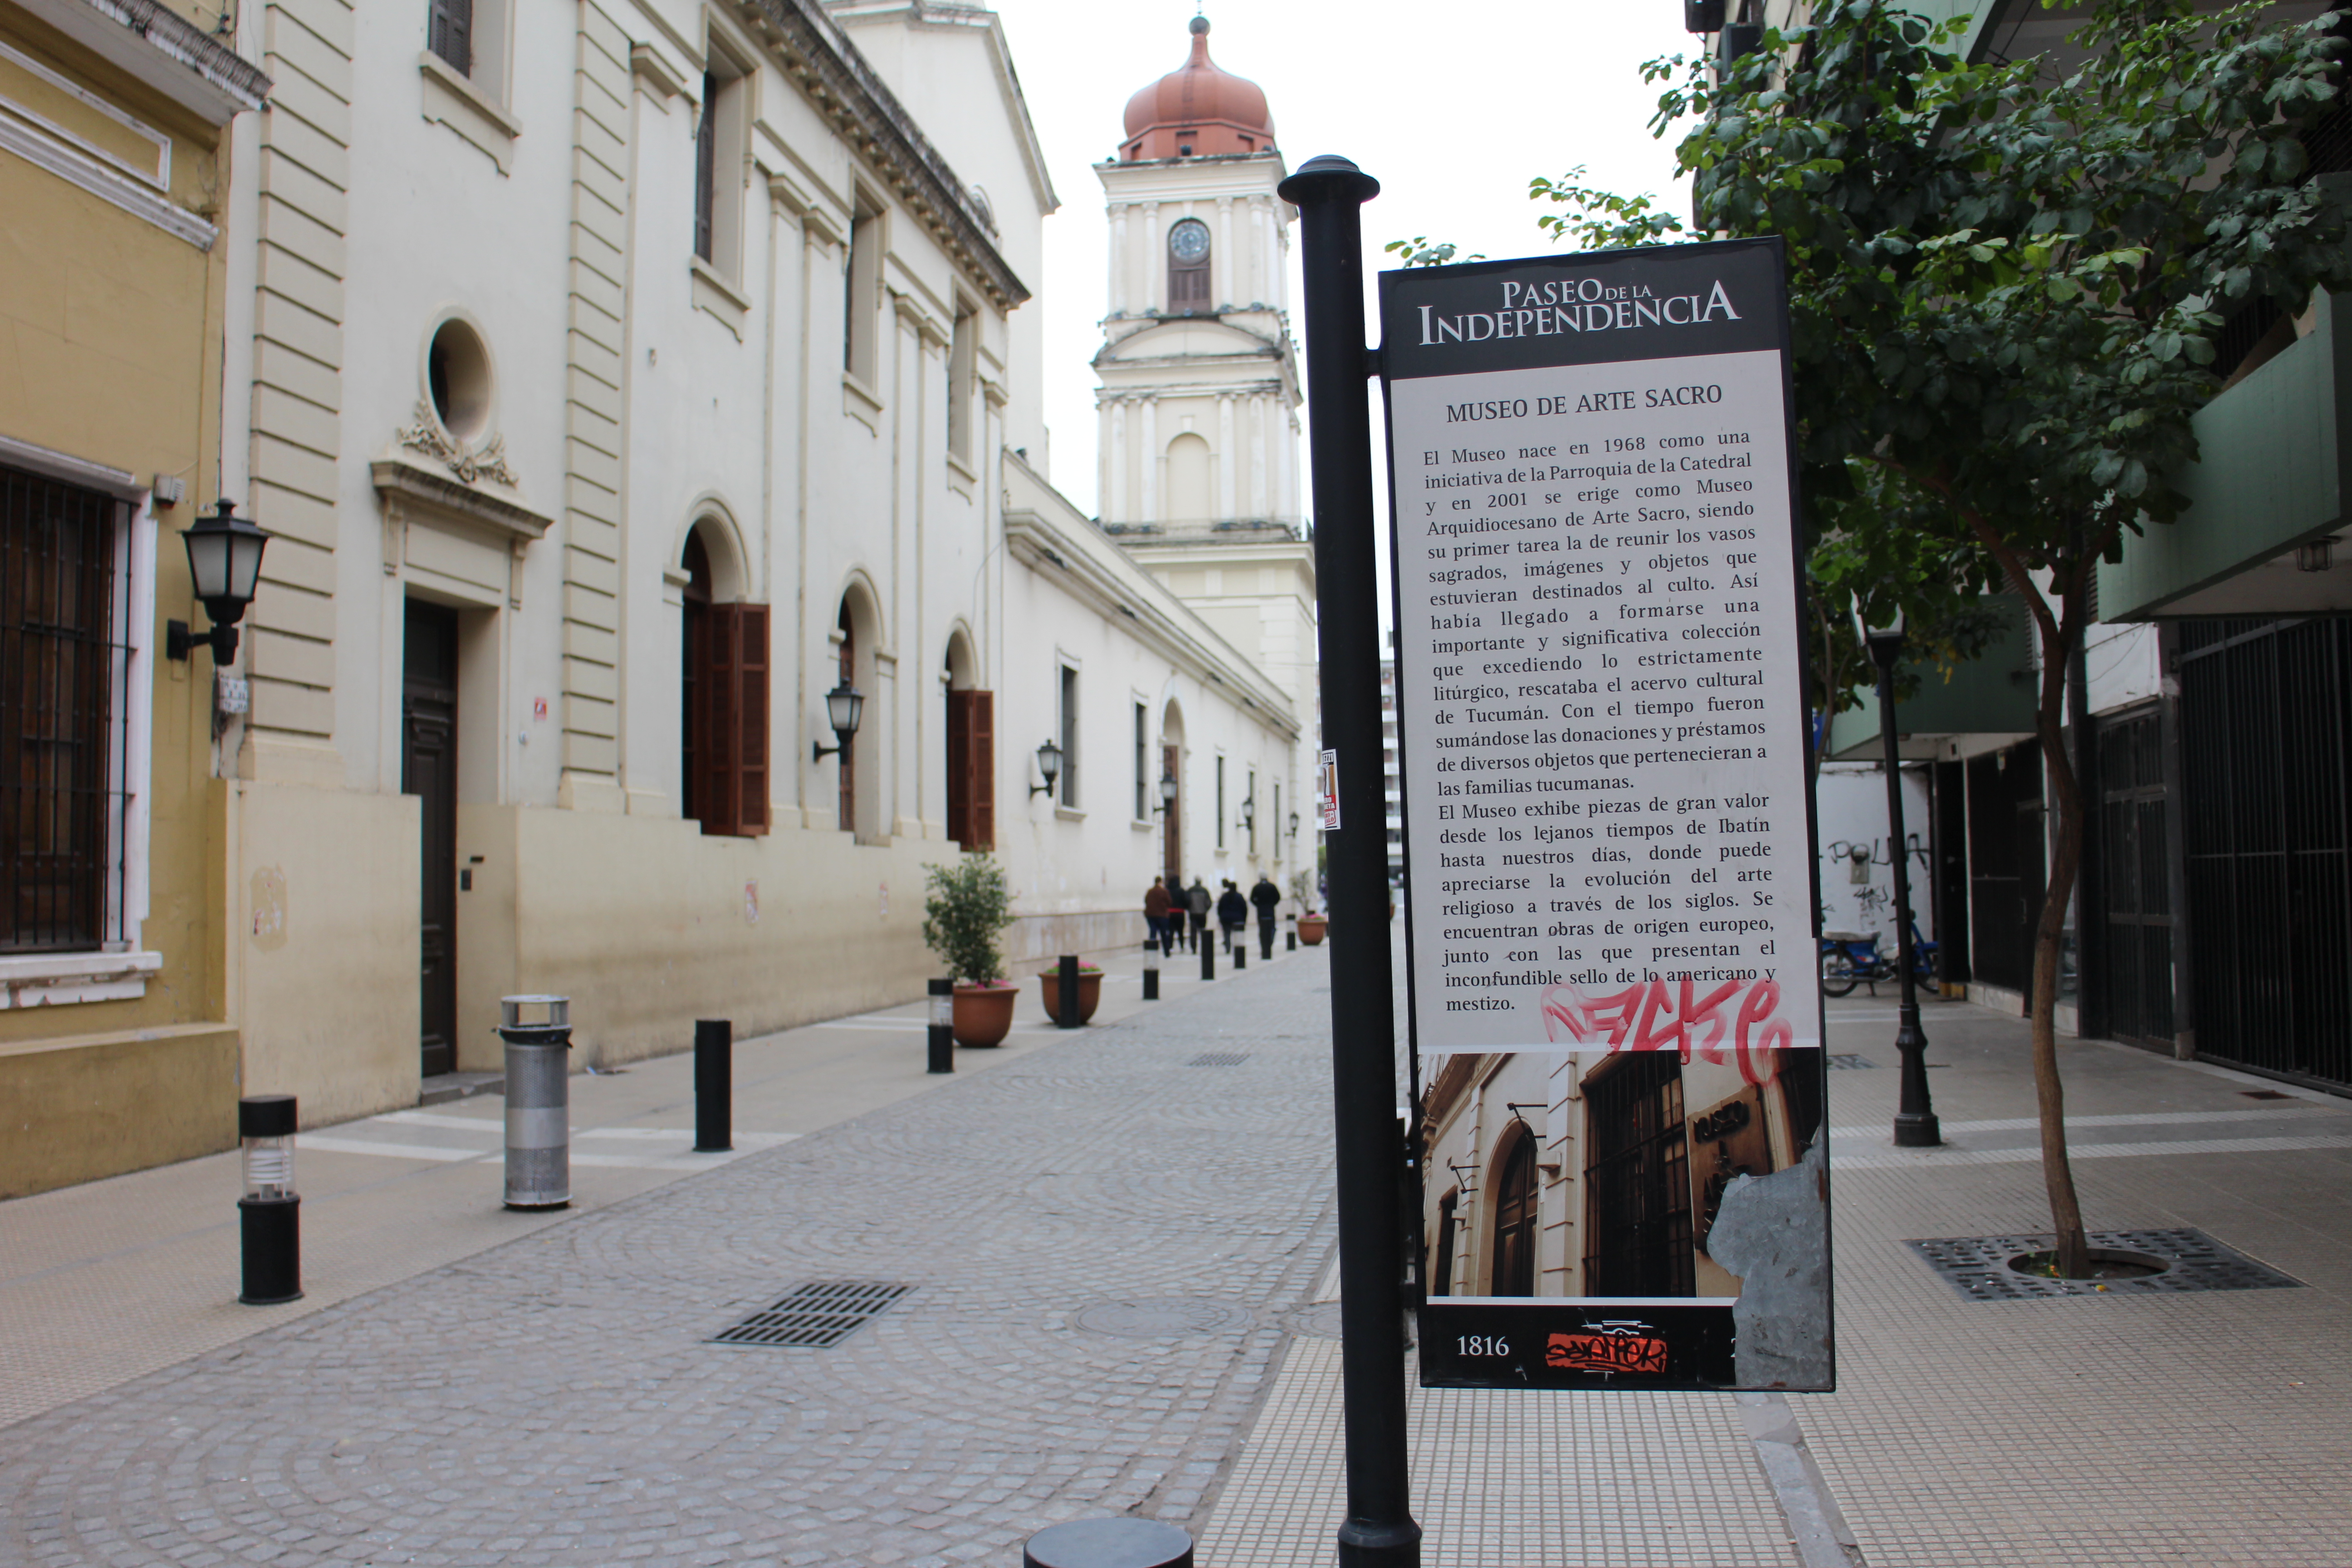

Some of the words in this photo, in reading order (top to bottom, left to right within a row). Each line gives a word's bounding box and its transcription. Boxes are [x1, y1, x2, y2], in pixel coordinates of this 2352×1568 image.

[1500, 278, 1602, 309] PASEO
[1605, 286, 1627, 300] DE
[1632, 285, 1653, 298] LA
[1417, 279, 1742, 346] INDEPENDENCIA
[1446, 398, 1529, 424] MUSEO
[1535, 395, 1568, 417] DE
[1574, 390, 1637, 414] ARTE
[1645, 383, 1723, 409] SACRO
[1423, 450, 1440, 466] El
[1450, 448, 1506, 464] Museo
[1518, 445, 1557, 459] nace
[1568, 443, 1590, 456] en
[1603, 436, 1646, 453] 1968
[1658, 435, 1705, 450] como
[1717, 432, 1751, 446] una
[1424, 470, 1504, 490] iniciativa
[1506, 468, 1527, 484] de
[1530, 466, 1546, 482] la
[1548, 461, 1633, 481] Parroquia
[1636, 459, 1656, 475] de
[1659, 457, 1676, 474] la
[1679, 451, 1752, 472] Catedral
[1425, 501, 1436, 517] y
[1451, 498, 1472, 511] en
[1487, 491, 1527, 509] 2001
[1544, 492, 1562, 505] se
[1577, 485, 1620, 505] erige
[1634, 484, 1681, 499] como
[1696, 478, 1754, 495] Museo
[1426, 516, 1558, 539] Arquidiocesano
[1564, 511, 1585, 528] de
[1591, 510, 1630, 525] Arte
[1637, 506, 1690, 523] Sacro,
[1697, 500, 1755, 519] siendo
[1427, 548, 1447, 560] su
[1452, 542, 1510, 562] primer
[1516, 539, 1560, 554] tarea
[1566, 535, 1583, 551] la
[1589, 533, 1609, 549] de
[1615, 529, 1671, 548] reunir
[1676, 528, 1701, 544] los
[1707, 528, 1756, 542] vasos
[1428, 564, 1508, 586] sagrados,
[1524, 560, 1604, 579] imágenes
[1620, 559, 1632, 576] y
[1647, 553, 1709, 573] objetos
[1725, 552, 1757, 569] que
[1429, 588, 1518, 607] estuvieran
[1532, 581, 1623, 601] destinados
[1637, 578, 1653, 595] al
[1667, 575, 1715, 593] culto.
[1729, 571, 1759, 589] Así
[1430, 612, 1482, 631] había
[1500, 607, 1569, 629] llegado
[1588, 609, 1600, 622] a
[1618, 603, 1705, 620] formarse
[1724, 600, 1761, 614] una
[1431, 635, 1525, 657] importante
[1537, 636, 1549, 652] y
[1562, 627, 1669, 651] significativa
[1681, 621, 1762, 641] colección
[1432, 665, 1464, 681] que
[1482, 654, 1583, 675] excediendo
[1601, 652, 1618, 669] lo
[1637, 647, 1763, 667] estrictamente
[1433, 684, 1509, 704] litúrgico,
[1517, 678, 1599, 697] rescataba
[1606, 676, 1622, 693] el
[1630, 677, 1688, 692] acervo
[1695, 669, 1764, 689] cultural
[1435, 709, 1455, 725] de
[1465, 705, 1549, 724] Tucumán.
[1561, 703, 1595, 719] Con
[1606, 700, 1622, 717] el
[1634, 699, 1695, 718] tiempo
[1707, 696, 1765, 712] fueron
[1435, 730, 1530, 749] sumándose
[1533, 729, 1557, 745] las
[1561, 725, 1657, 744] donaciones
[1660, 726, 1673, 743] y
[1676, 720, 1766, 743] préstamos
[1436, 757, 1457, 773] de
[1460, 755, 1530, 772] diversos
[1534, 752, 1595, 772] objetos
[1598, 753, 1630, 770] que
[1633, 745, 1753, 768] pertenecieran
[1756, 746, 1768, 759] a
[1437, 781, 1461, 797] las
[1464, 778, 1533, 796] familias
[1535, 777, 1635, 793] tucumanas.
[1438, 804, 1455, 821] El
[1461, 803, 1517, 819] Museo
[1524, 799, 1581, 817] exhibe
[1587, 799, 1641, 819] piezas
[1648, 795, 1669, 813] de
[1676, 797, 1717, 815] gran
[1723, 792, 1770, 809] valor
[1439, 827, 1487, 845] desde
[1498, 826, 1523, 843] los
[1533, 824, 1594, 845] lejanos
[1605, 822, 1675, 841] tiempos
[1686, 818, 1707, 836] de
[1718, 816, 1771, 834] Ibatín
[1439, 852, 1486, 868] hasta
[1501, 850, 1575, 866] nuestros
[1591, 846, 1632, 864] días,
[1648, 843, 1702, 861] donde
[1718, 840, 1772, 863] puede
[1441, 875, 1531, 896] apreciarse
[1548, 872, 1566, 889] la
[1584, 868, 1671, 887] evolución
[1690, 867, 1718, 884] del
[1736, 867, 1773, 883] arte
[1441, 899, 1515, 919] religioso
[1527, 902, 1538, 914] a
[1549, 895, 1602, 913] través
[1614, 894, 1636, 911] de
[1647, 894, 1673, 910] los
[1684, 892, 1740, 913] siglos.
[1753, 890, 1774, 907] Se
[1443, 924, 1539, 940] encuentran
[1547, 920, 1594, 937] obras
[1603, 919, 1624, 936] de
[1633, 918, 1690, 938] origen
[1699, 918, 1774, 936] europeo,
[1441, 948, 1490, 968] junto
[1508, 950, 1539, 962] con
[1557, 945, 1583, 961] las
[1601, 947, 1633, 964] que
[1651, 942, 1741, 963] presentan
[1759, 939, 1776, 956] el
[1445, 969, 1563, 988] inconfundible
[1569, 968, 1609, 985] sello
[1615, 967, 1636, 984] de
[1642, 966, 1660, 983] lo
[1666, 965, 1758, 983] americano
[1764, 967, 1777, 984] y
[1445, 995, 1516, 1012] mestizo.
[1457, 1335, 1509, 1356] 1816
